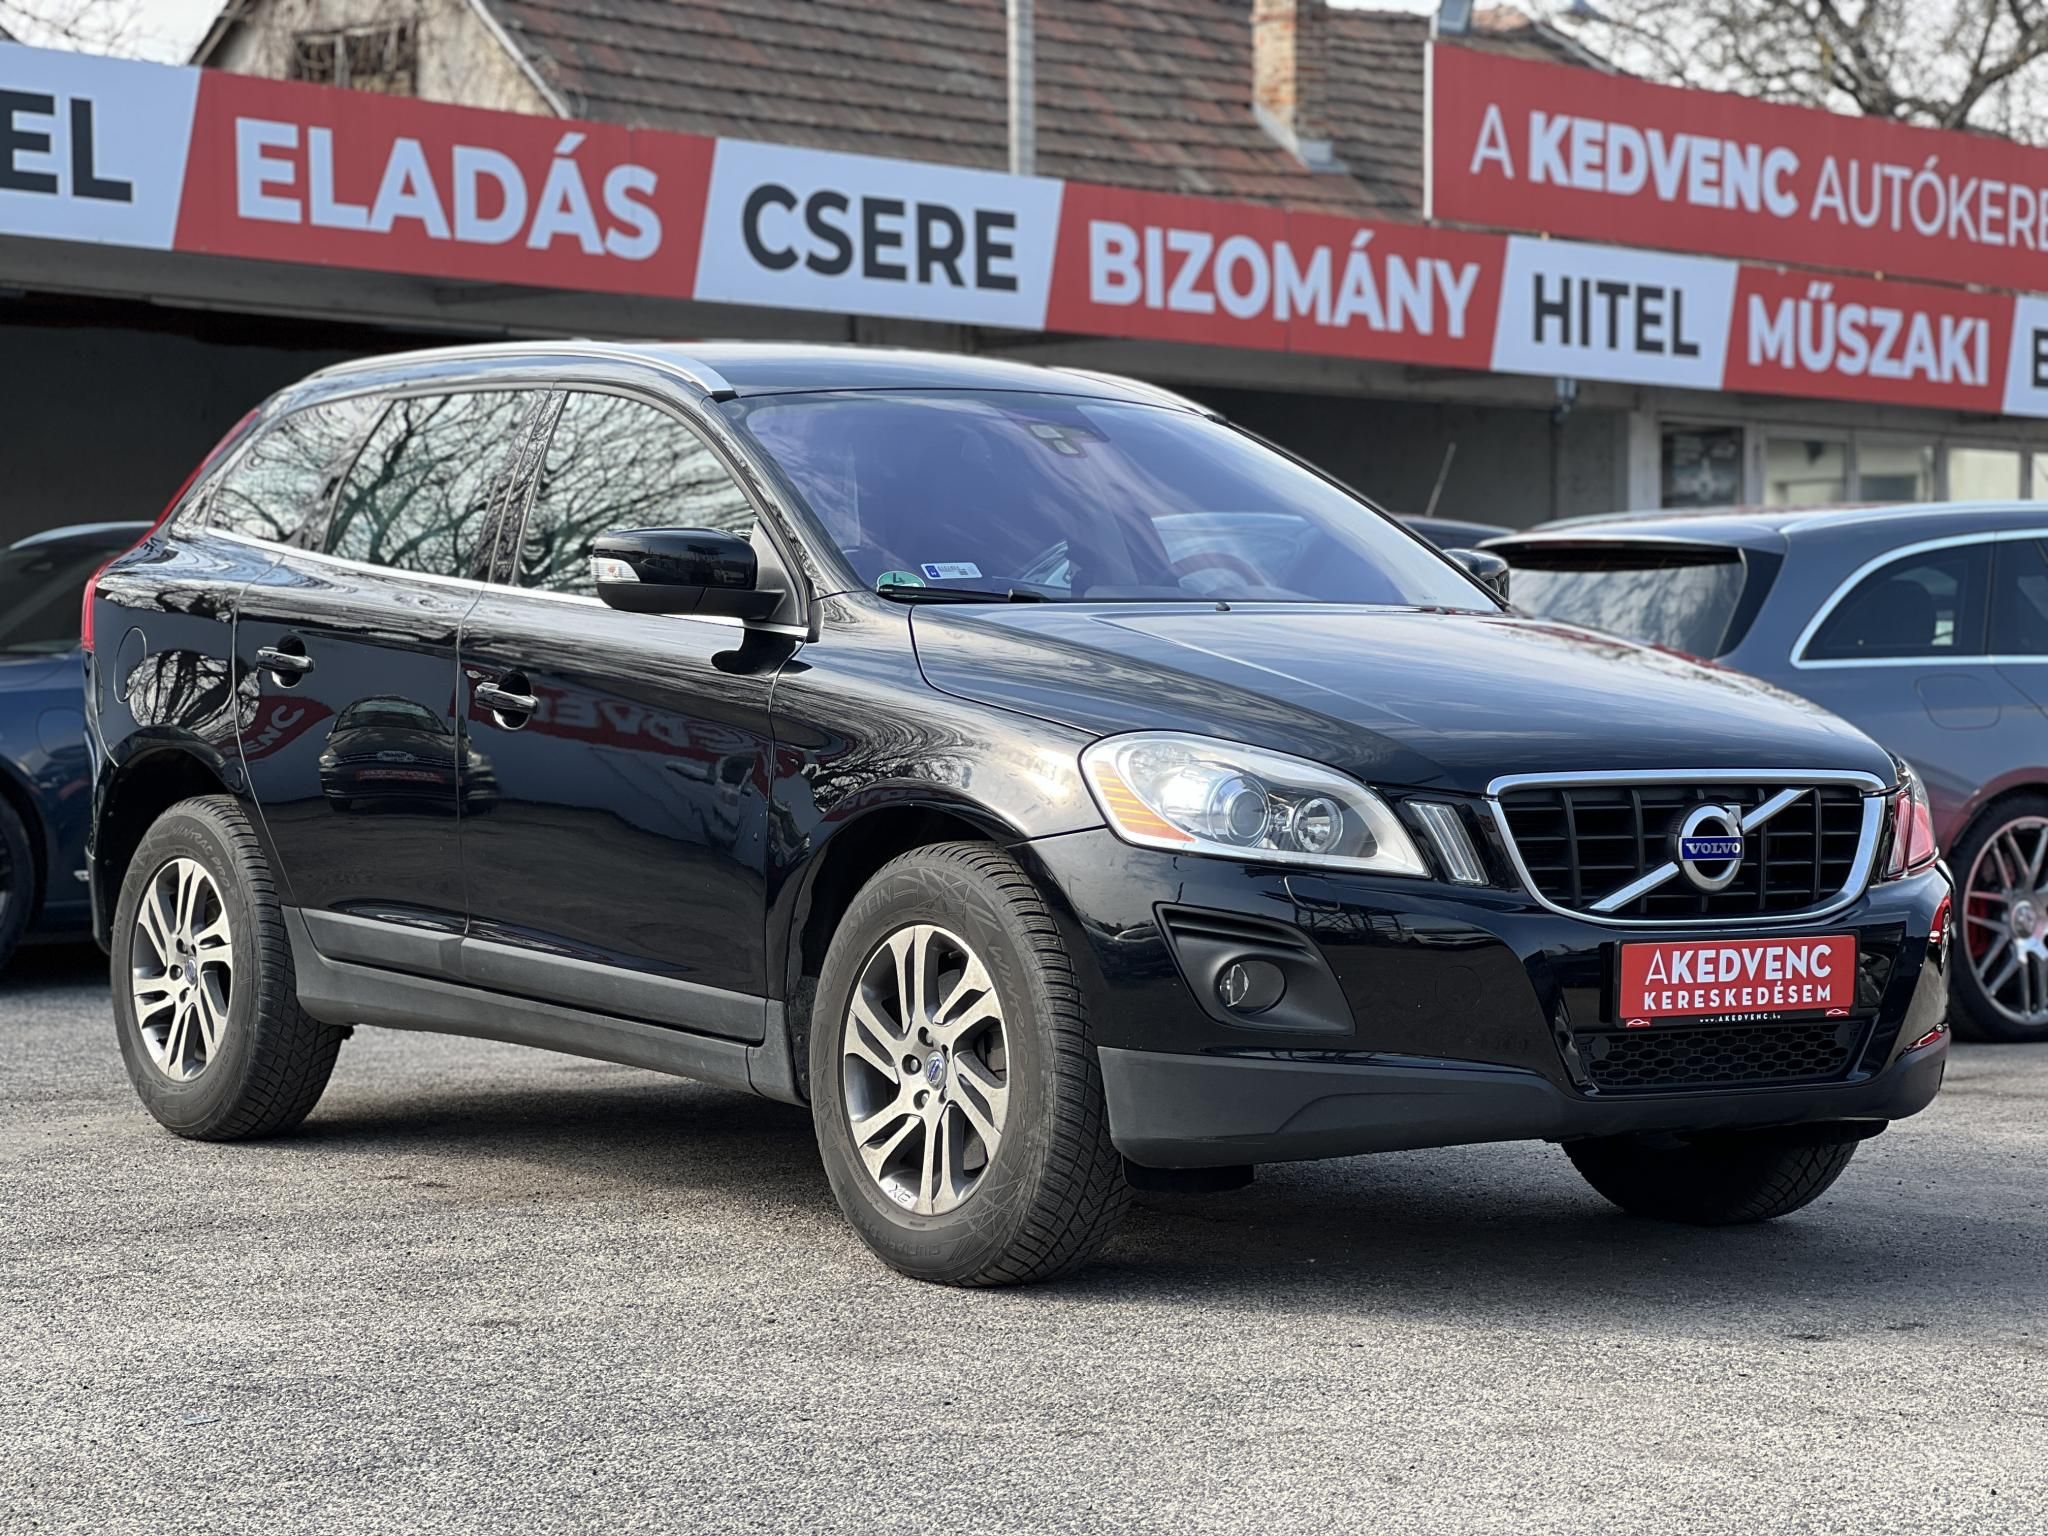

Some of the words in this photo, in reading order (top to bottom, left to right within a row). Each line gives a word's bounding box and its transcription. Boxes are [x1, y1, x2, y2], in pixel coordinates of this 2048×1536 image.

[235, 116, 663, 261] ELADÁS
[1470, 103, 1514, 179] A
[1528, 110, 1799, 218] KEDVENC
[742, 184, 1018, 292] CSERE
[1088, 220, 1481, 339] BIZOMÁNY
[1533, 273, 1699, 357] HITEL
[1748, 280, 1989, 386] MŰSZAKI
[1685, 842, 1741, 854] VOLVO
[1644, 981, 1831, 1010] KERESKEDÉSEM
